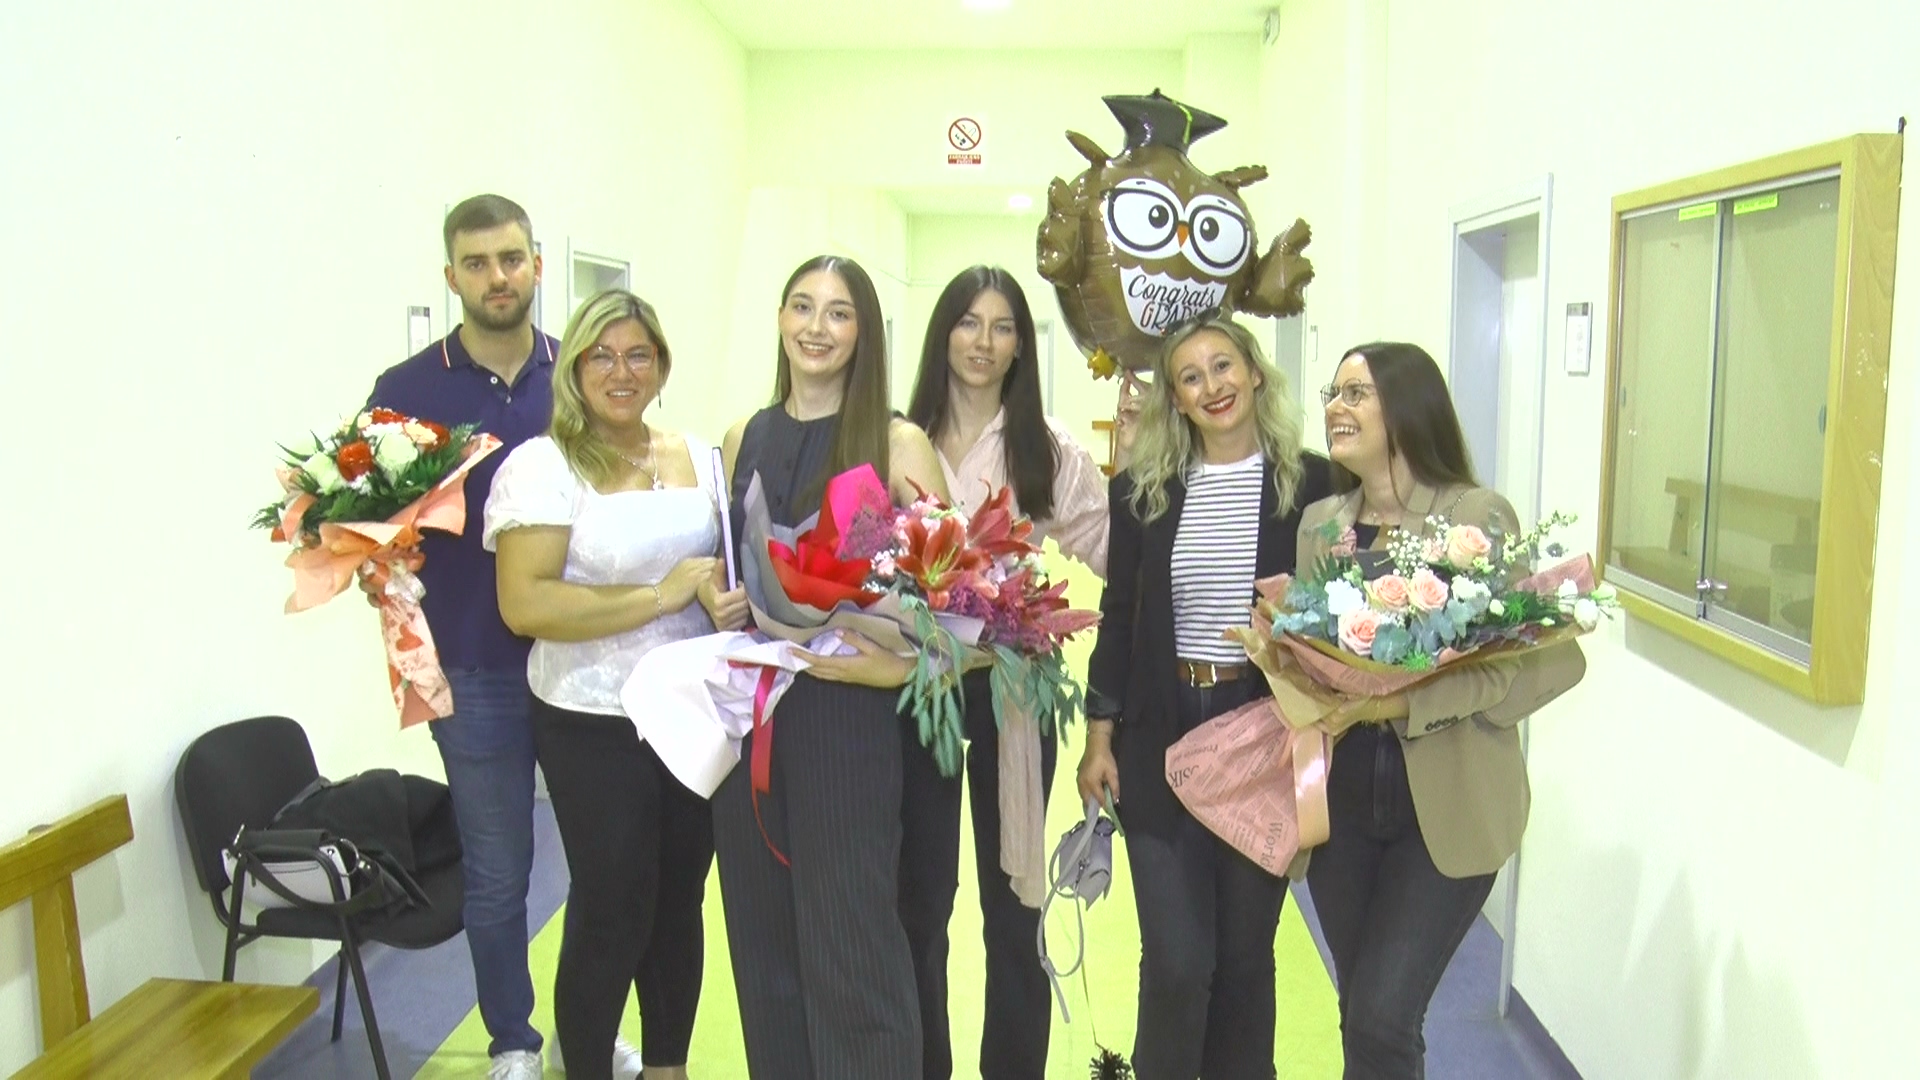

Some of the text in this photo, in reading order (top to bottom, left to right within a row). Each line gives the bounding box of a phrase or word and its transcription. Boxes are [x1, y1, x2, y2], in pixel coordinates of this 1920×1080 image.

[1128, 274, 1215, 308] Congrats
[1140, 301, 1198, 330] GRAD
[1260, 822, 1283, 869] World
